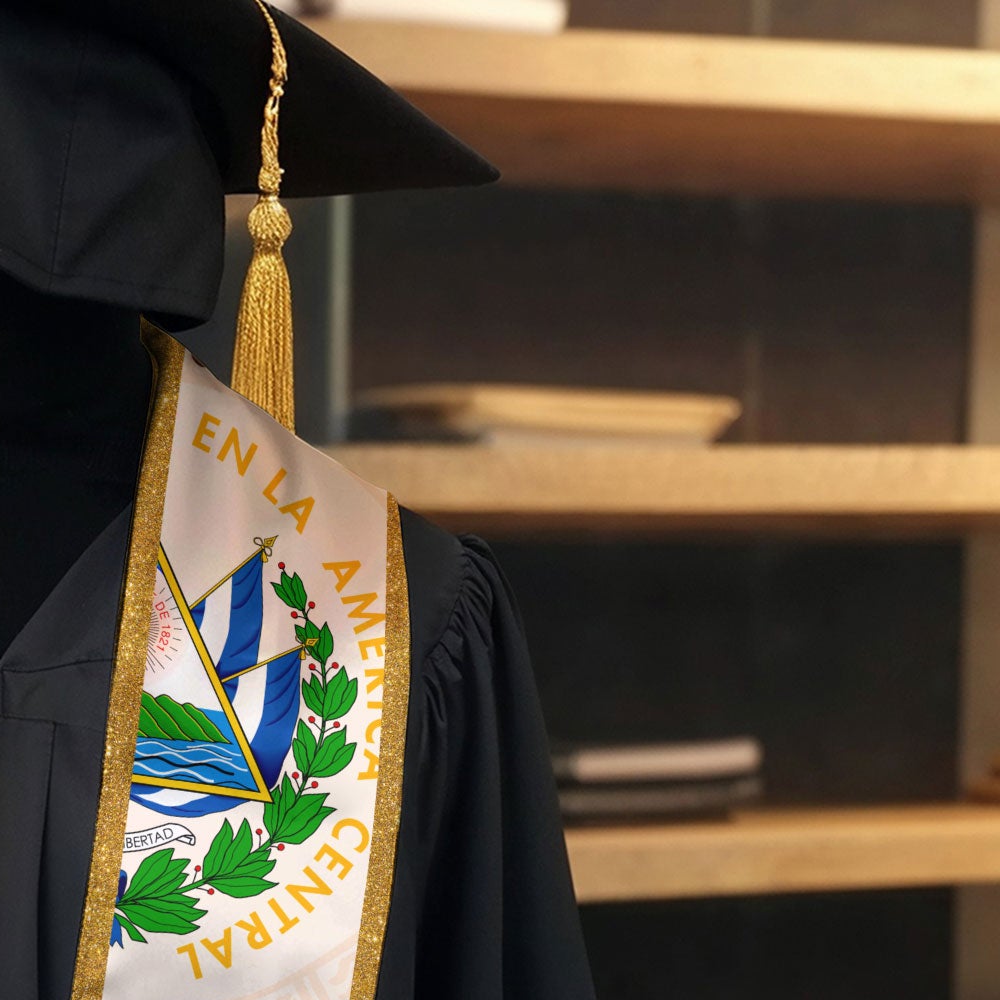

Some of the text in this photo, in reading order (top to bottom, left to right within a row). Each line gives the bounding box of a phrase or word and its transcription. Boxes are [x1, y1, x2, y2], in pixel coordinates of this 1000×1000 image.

[191, 412, 258, 477] EN
[262, 468, 315, 534] LA
[155, 601, 171, 652] DE 1821
[123, 828, 174, 849] BERTAD
[176, 818, 370, 979] CENTRAL
